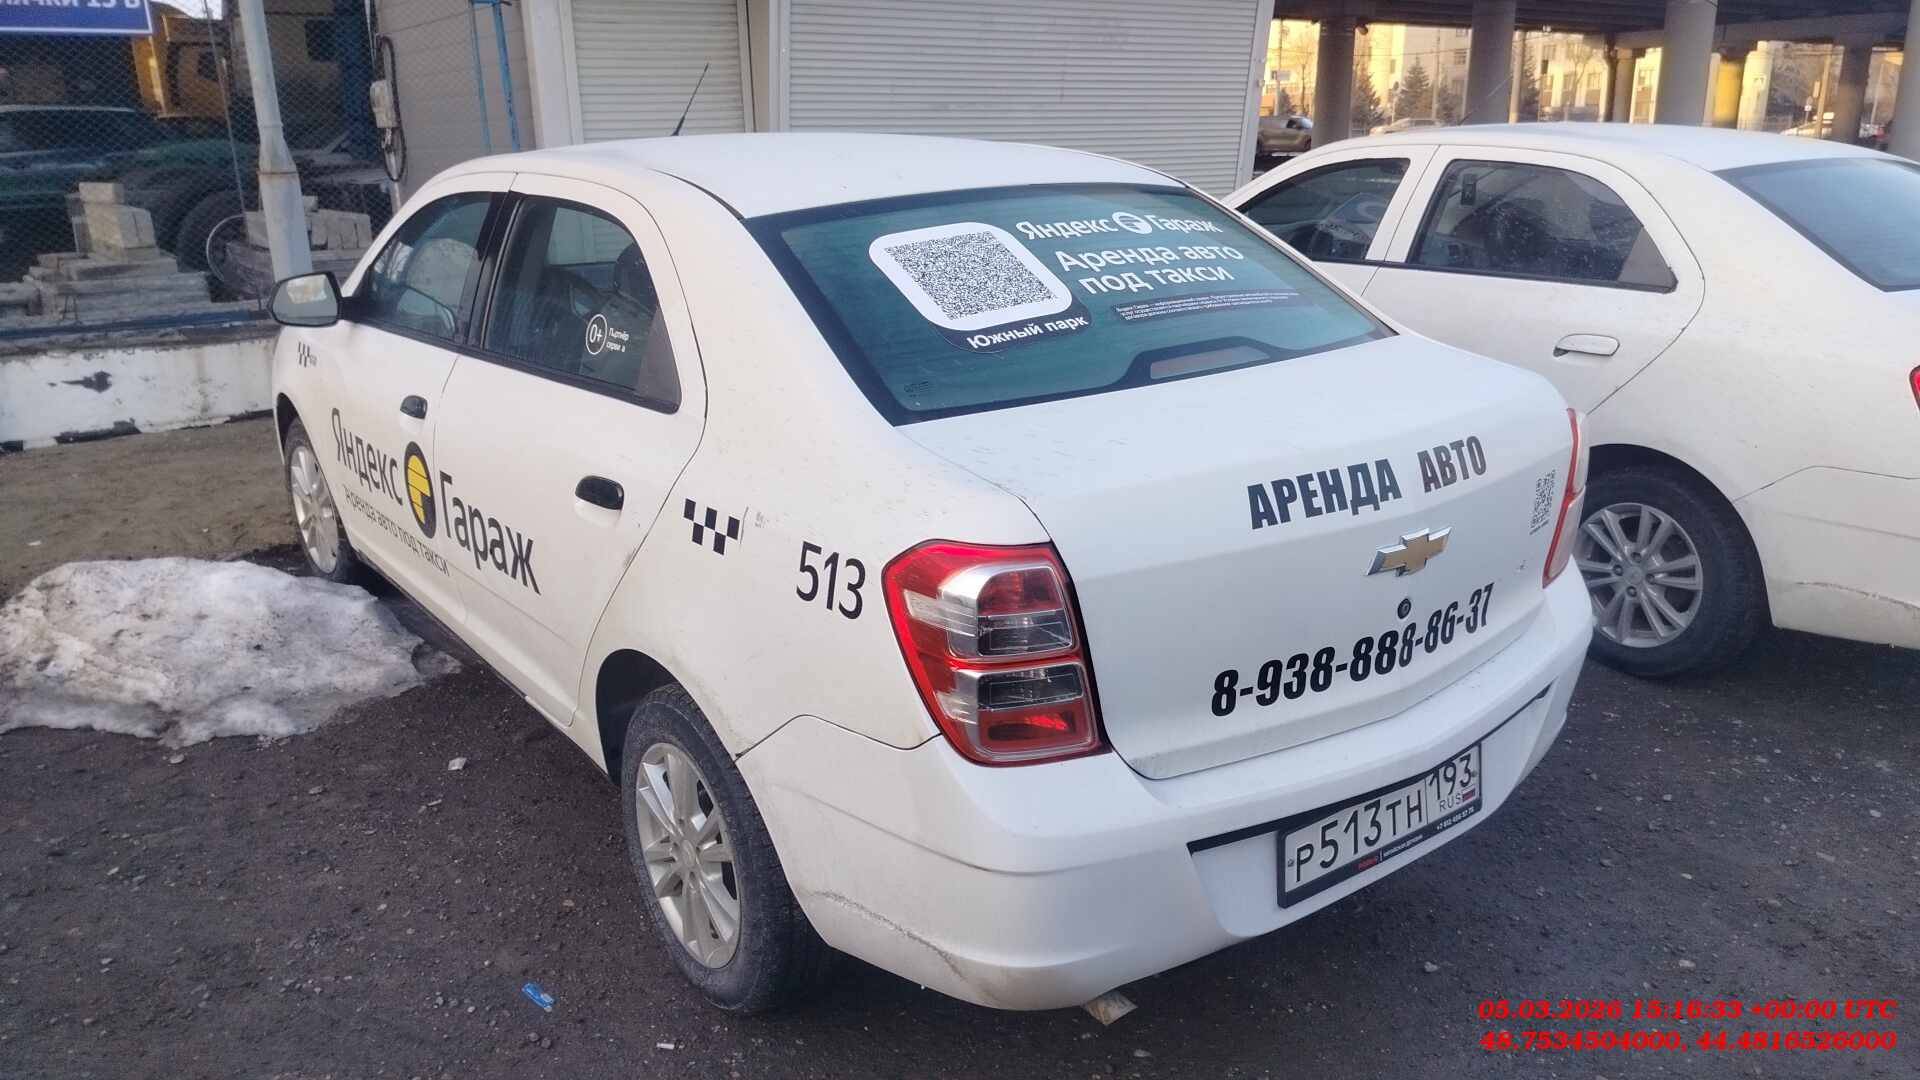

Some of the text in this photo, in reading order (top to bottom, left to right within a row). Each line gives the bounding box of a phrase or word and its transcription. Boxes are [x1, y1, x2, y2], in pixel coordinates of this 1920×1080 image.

[1016, 213, 1224, 241] Яндекс Гараж
[1055, 245, 1244, 273] Аренда авто
[1078, 265, 1235, 295] под такси
[967, 316, 1089, 349] Южный парк
[330, 407, 542, 597] Яндекс Гараж
[1247, 435, 1488, 531] АРЕНДА АВТО
[375, 508, 400, 540] авто
[398, 524, 419, 556] под
[417, 540, 451, 578] такси
[796, 540, 866, 620] 513
[1211, 582, 1495, 717] 8-938-888-86-37
[1428, 753, 1472, 801] 193
[1438, 792, 1462, 813] RUS
